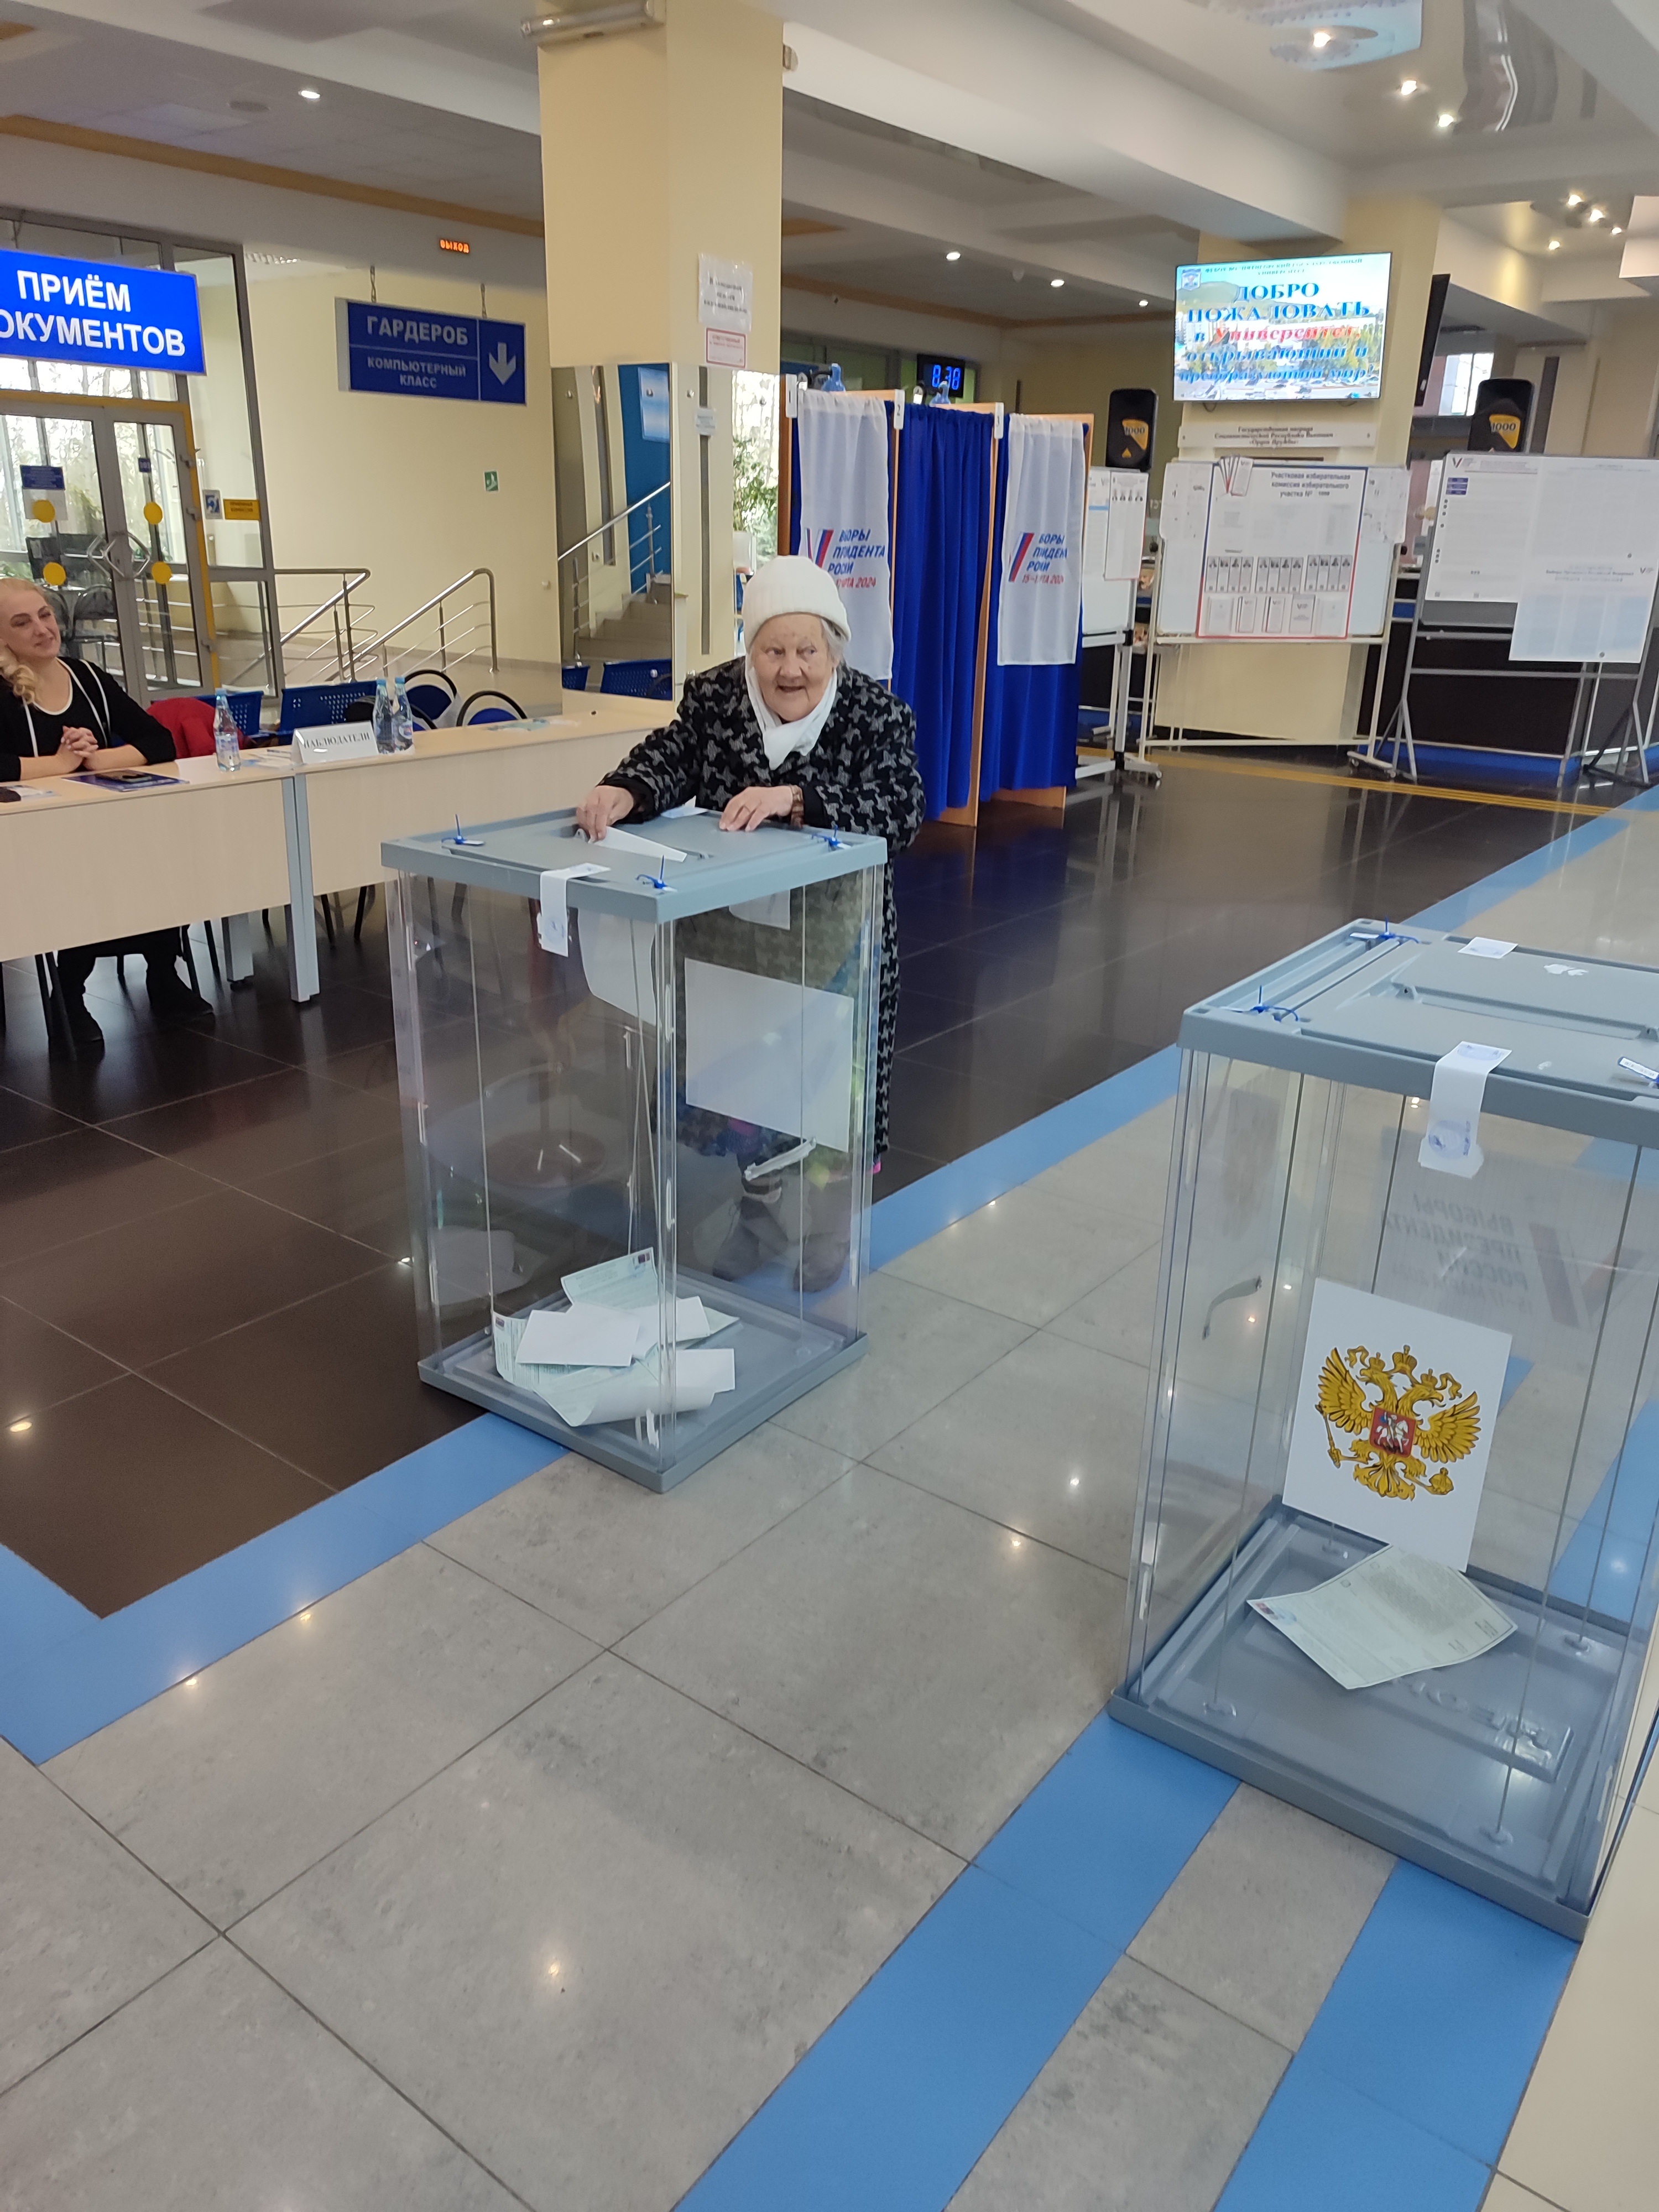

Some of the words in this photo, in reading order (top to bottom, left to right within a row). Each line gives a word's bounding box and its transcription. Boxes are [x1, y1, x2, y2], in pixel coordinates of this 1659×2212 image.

[440, 239, 469, 253] ВЫХОД
[17, 269, 132, 312] ПРИЁМ
[1233, 283, 1319, 304] ДОБРО
[1188, 301, 1370, 324] ПОЖАЛОВАТЬ
[367, 315, 468, 346] ГАРДЕРОБ
[367, 356, 466, 377] КОМПЬЮТЕРНЫЙ
[400, 374, 437, 388] КЛАСС
[896, 404, 901, 416] 2
[855, 576, 877, 588] 2024
[304, 732, 371, 749] НАБЛЮДАТЕЛИ
